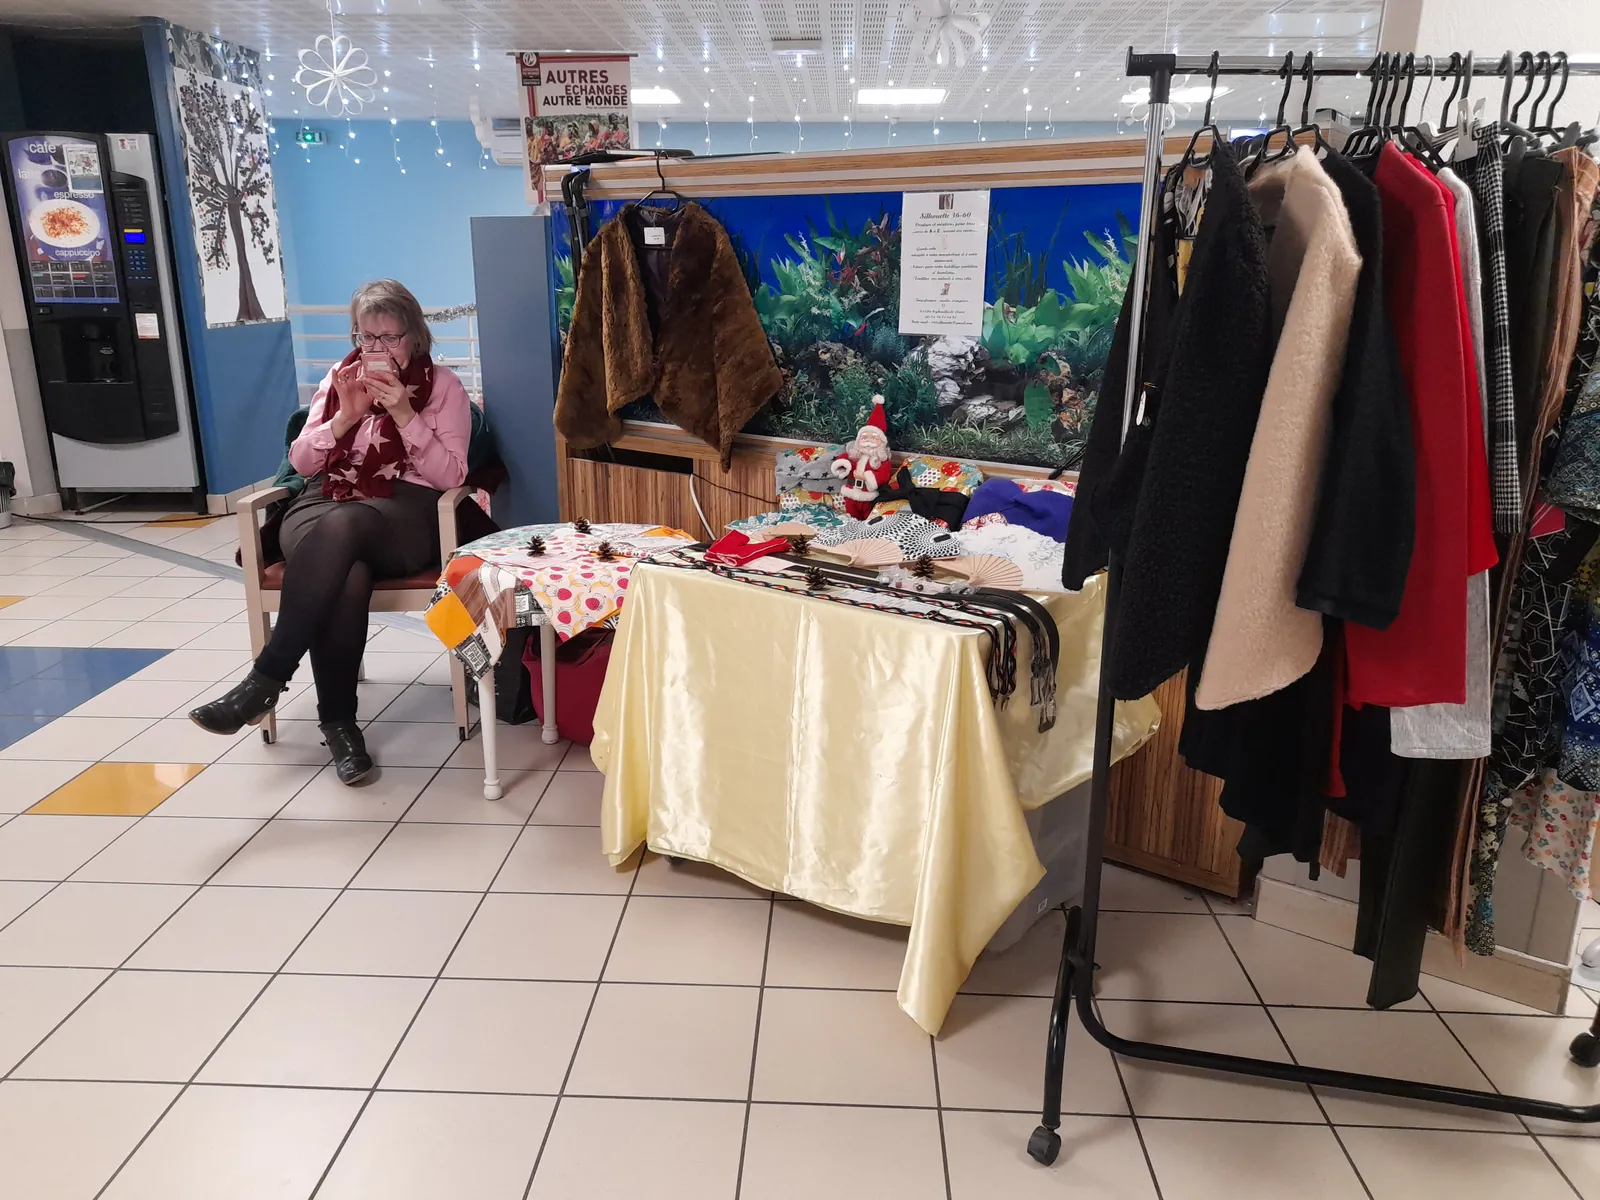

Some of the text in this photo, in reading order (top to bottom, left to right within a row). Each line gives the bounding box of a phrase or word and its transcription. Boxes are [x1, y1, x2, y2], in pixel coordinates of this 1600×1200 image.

[546, 70, 609, 84] AUTRES
[543, 95, 628, 106] AUTRE MONDE
[53, 191, 95, 200] espresso
[55, 248, 101, 257] cappuccino
